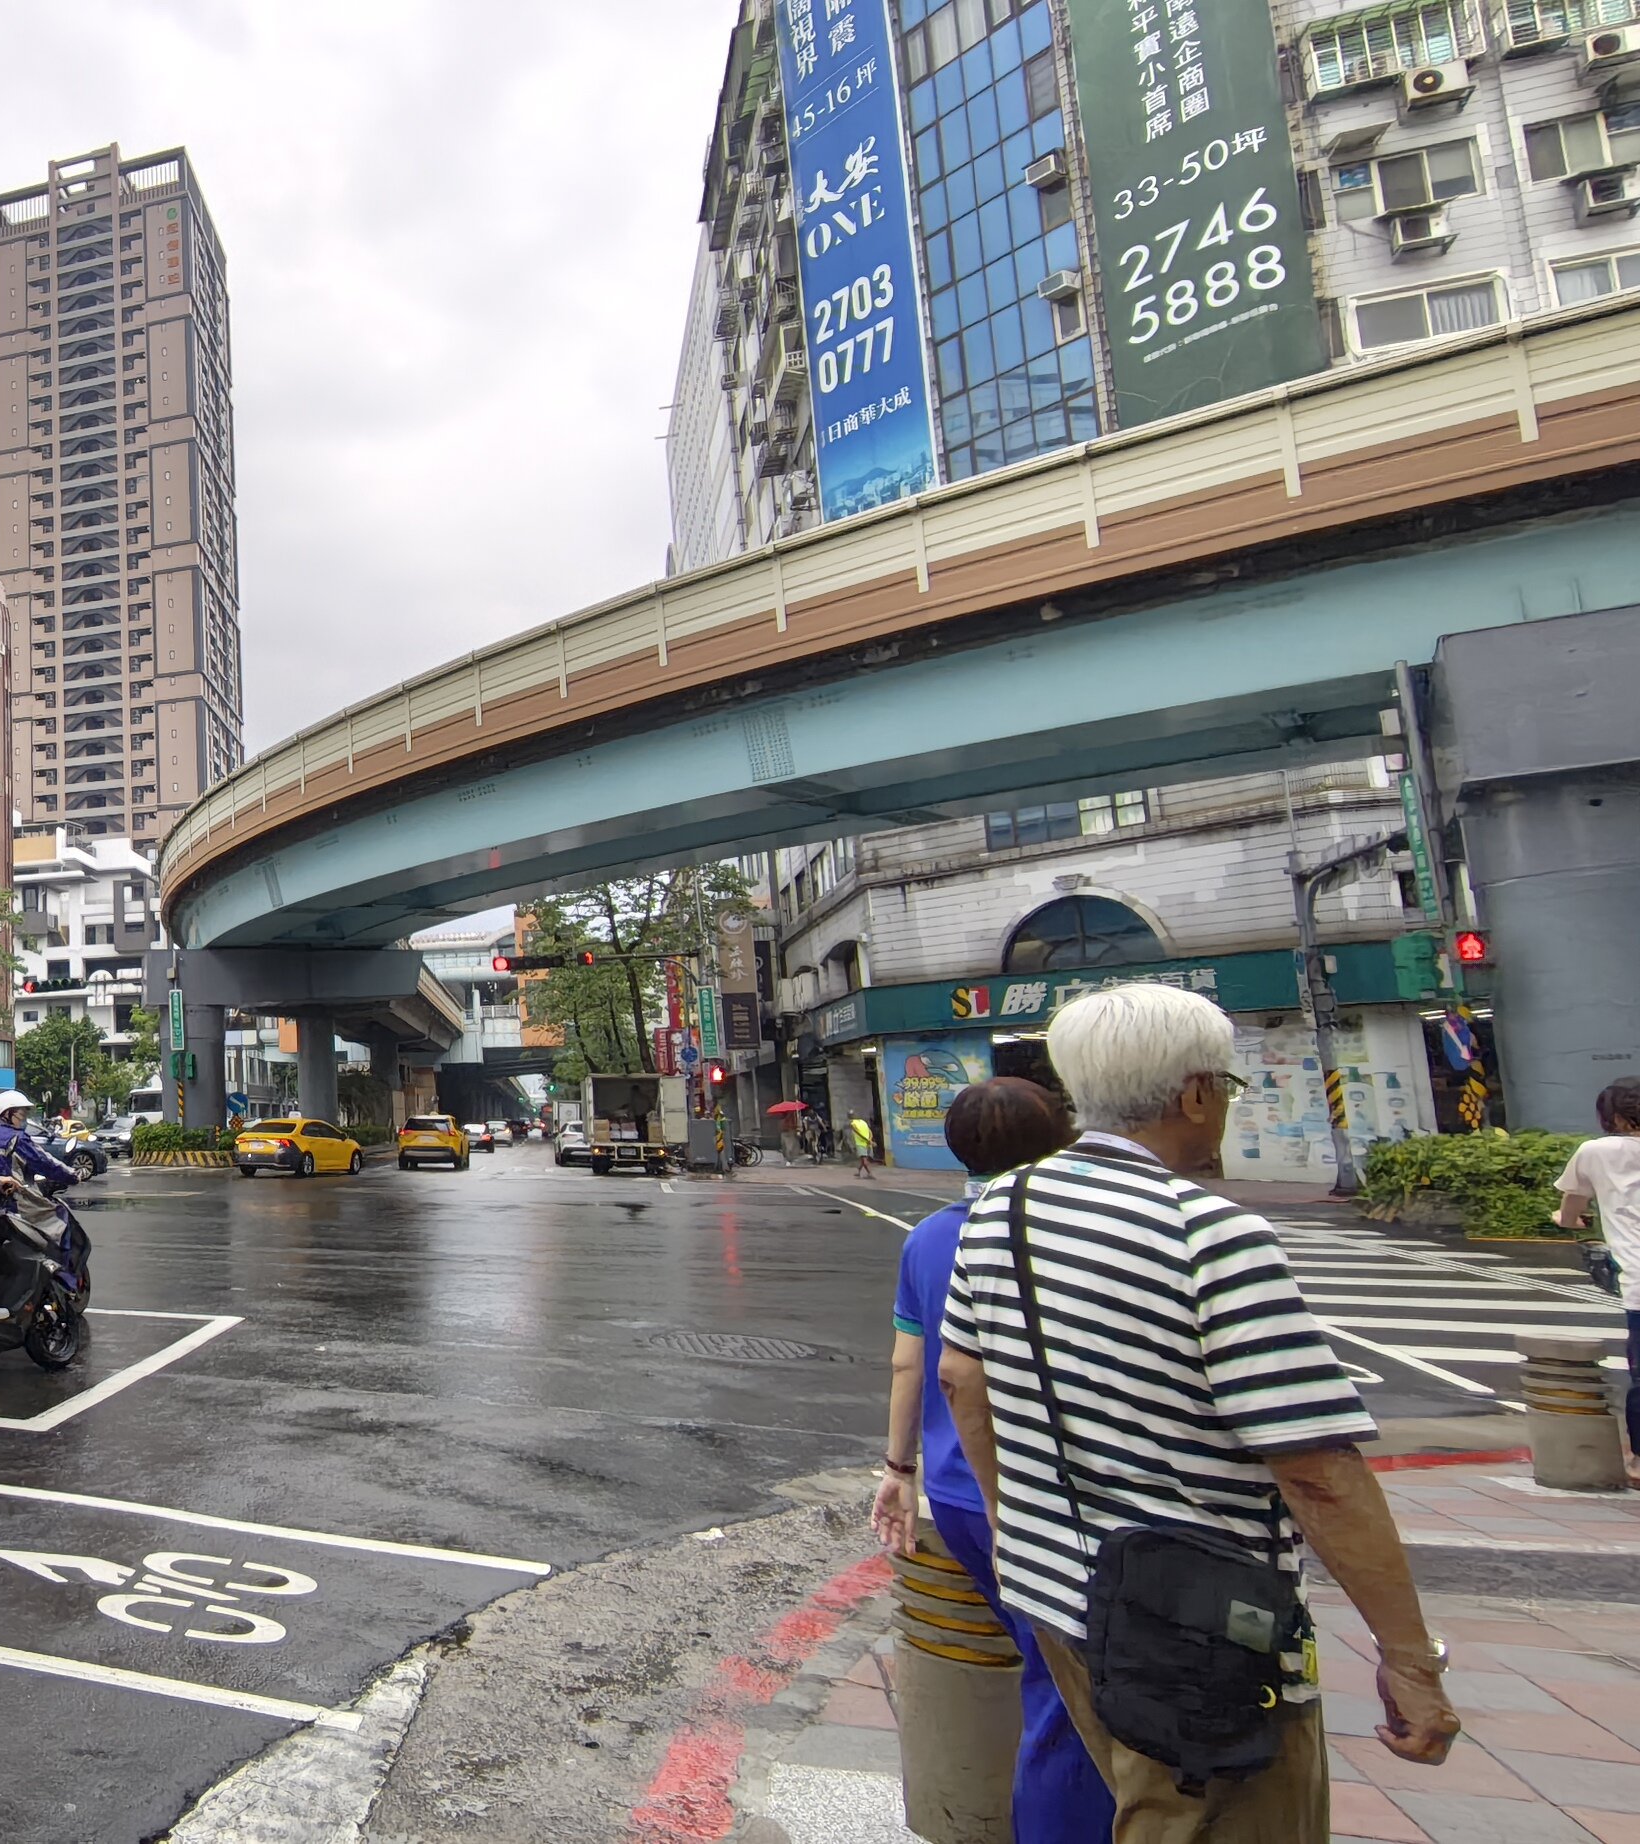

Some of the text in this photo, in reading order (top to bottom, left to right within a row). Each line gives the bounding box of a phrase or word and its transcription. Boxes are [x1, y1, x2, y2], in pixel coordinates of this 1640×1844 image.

[804, 136, 879, 214] 大安
[1118, 187, 1278, 293] 2746
[814, 263, 894, 345] 2703
[1127, 244, 1286, 344] 5888
[818, 316, 895, 394] 0777
